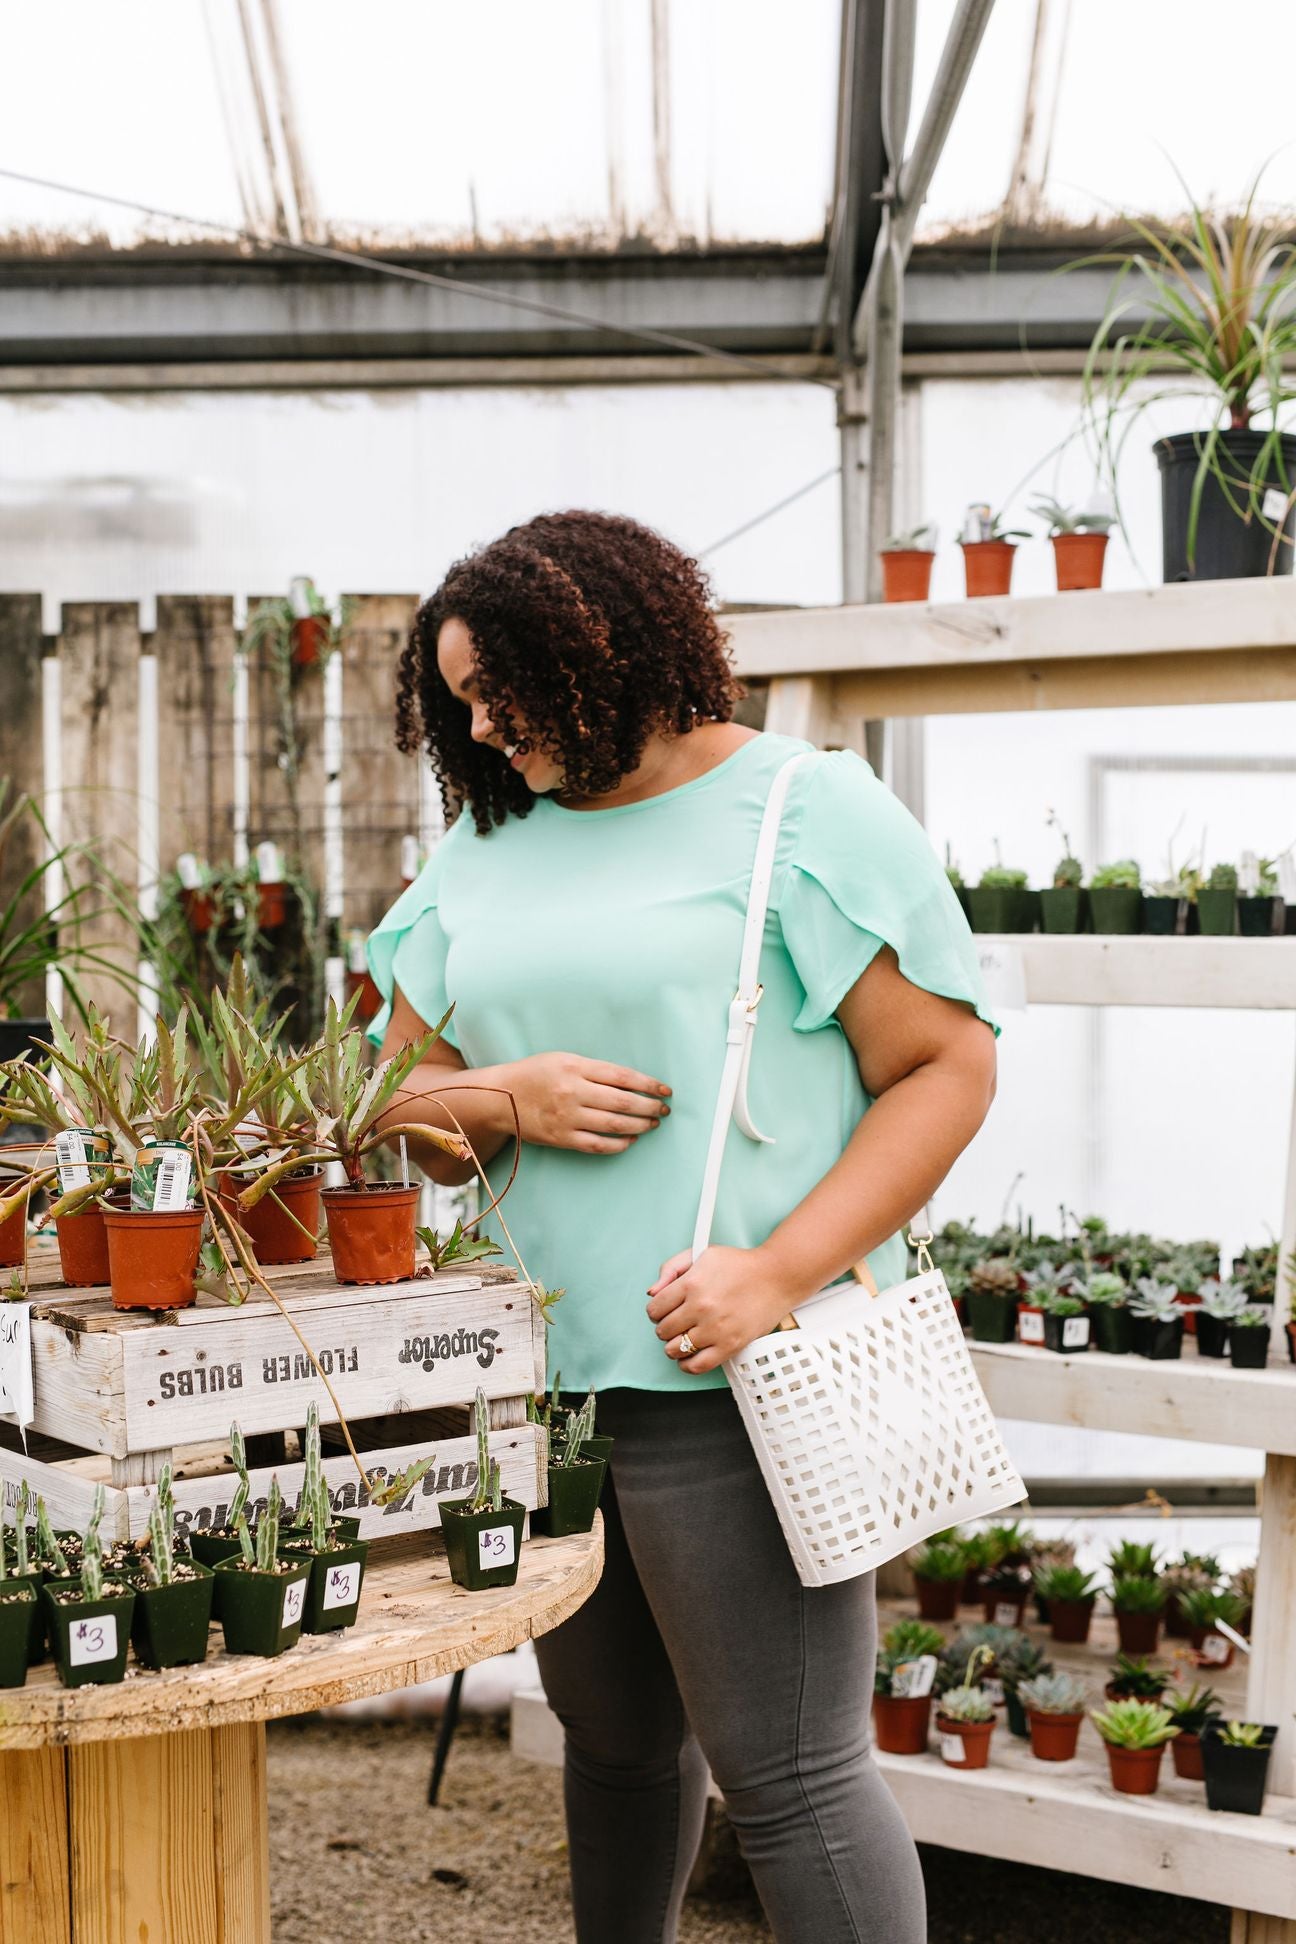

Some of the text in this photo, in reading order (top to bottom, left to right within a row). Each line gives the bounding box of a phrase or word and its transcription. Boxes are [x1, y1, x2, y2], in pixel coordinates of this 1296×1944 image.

[159, 1328, 500, 1400] Superior FLOWER BULBS
[480, 1532, 506, 1556] $3
[329, 1569, 350, 1600] $3
[287, 1589, 300, 1617] $3
[76, 1622, 104, 1652] $3
